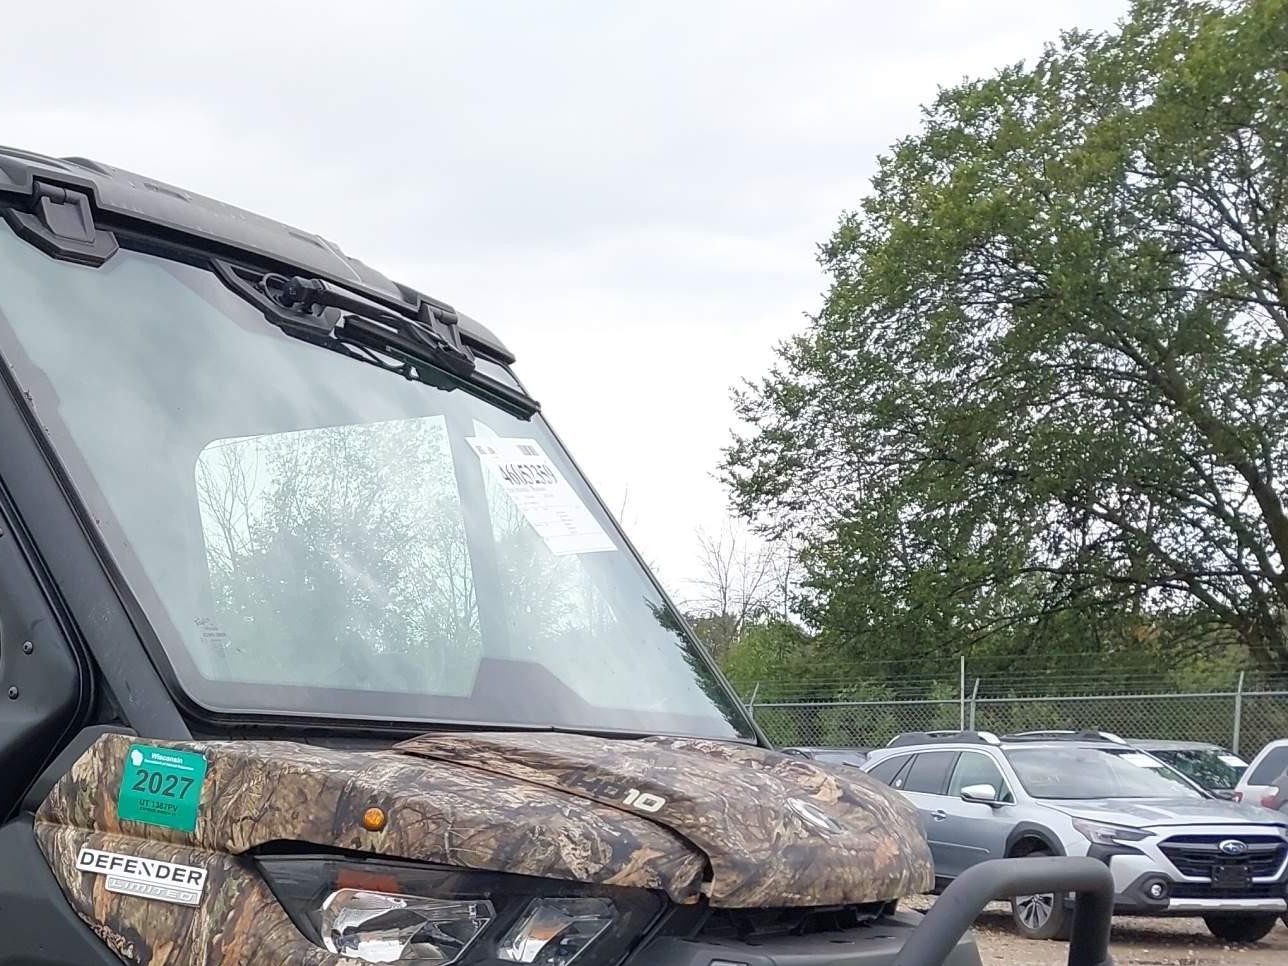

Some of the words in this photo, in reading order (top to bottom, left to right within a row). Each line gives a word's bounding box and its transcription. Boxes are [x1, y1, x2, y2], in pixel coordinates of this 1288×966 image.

[151, 752, 184, 765] Wisconsin
[131, 768, 194, 800] 2027
[80, 851, 203, 886] DEFENDER
